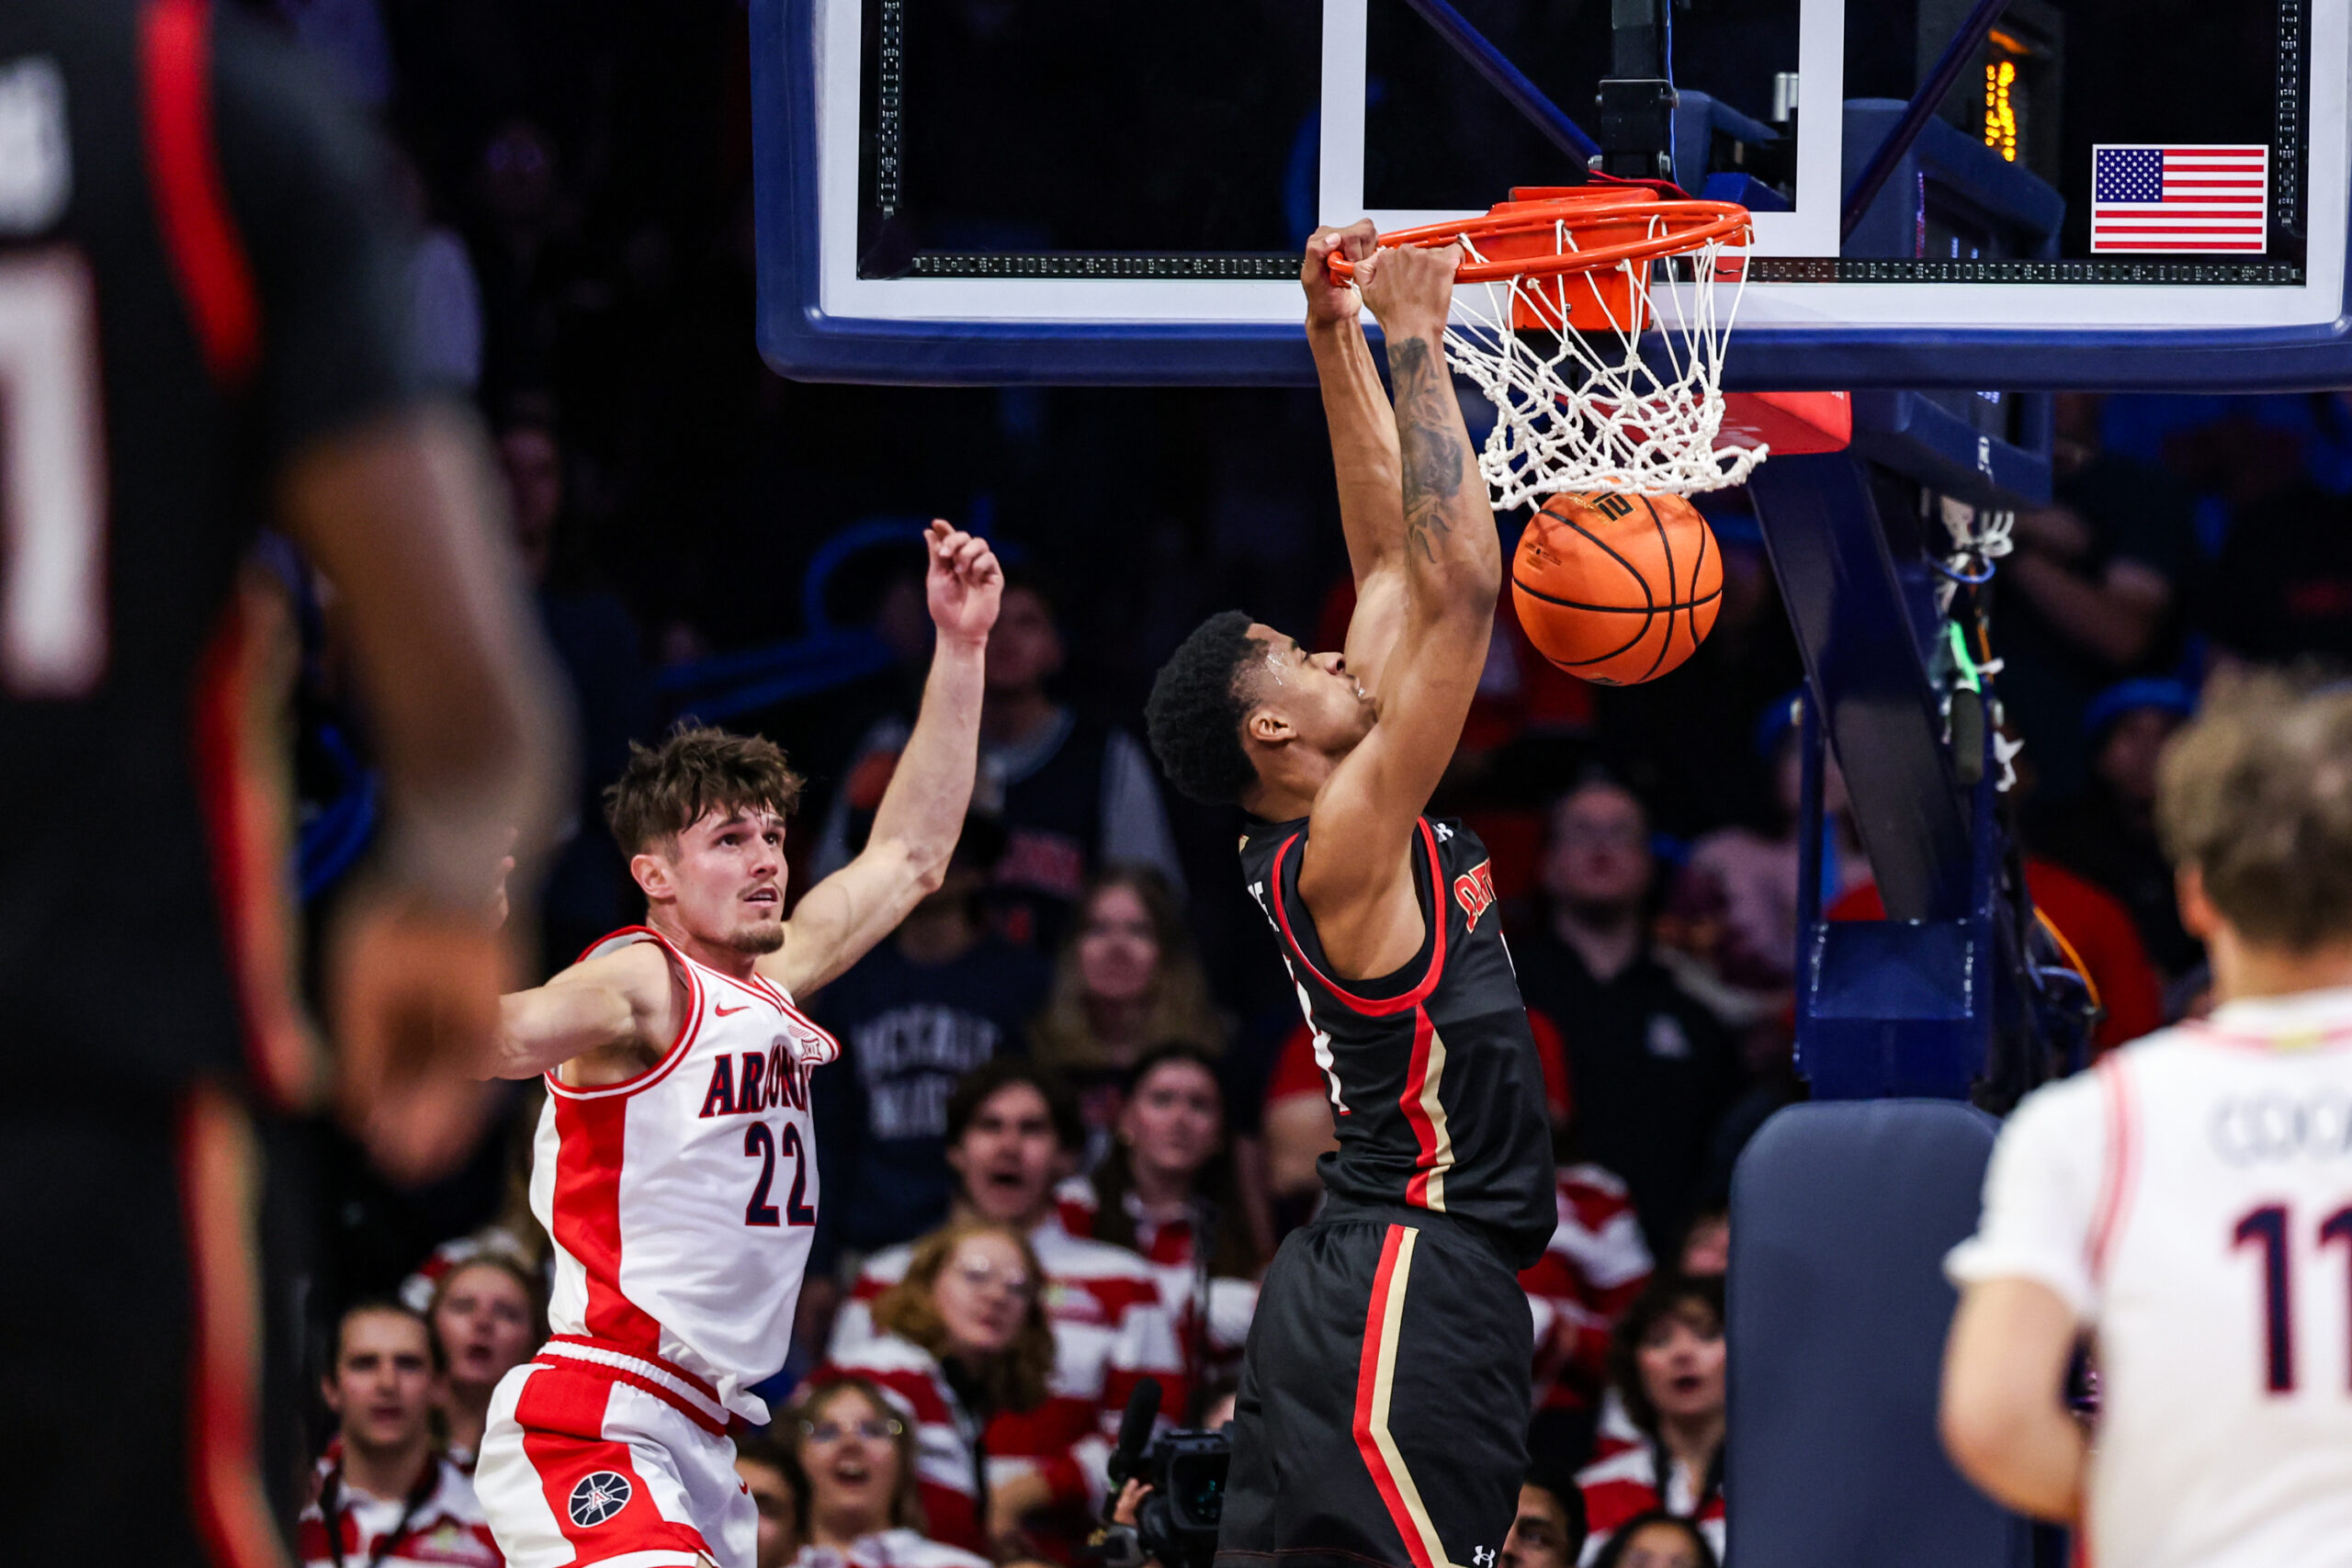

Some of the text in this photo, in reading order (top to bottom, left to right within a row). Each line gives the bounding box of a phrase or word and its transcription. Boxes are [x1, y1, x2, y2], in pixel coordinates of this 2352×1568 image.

[744, 1121, 816, 1227] 22
[2207, 1085, 2352, 1171] COO
[2227, 1198, 2352, 1400] 11
[586, 1484, 614, 1513] A
